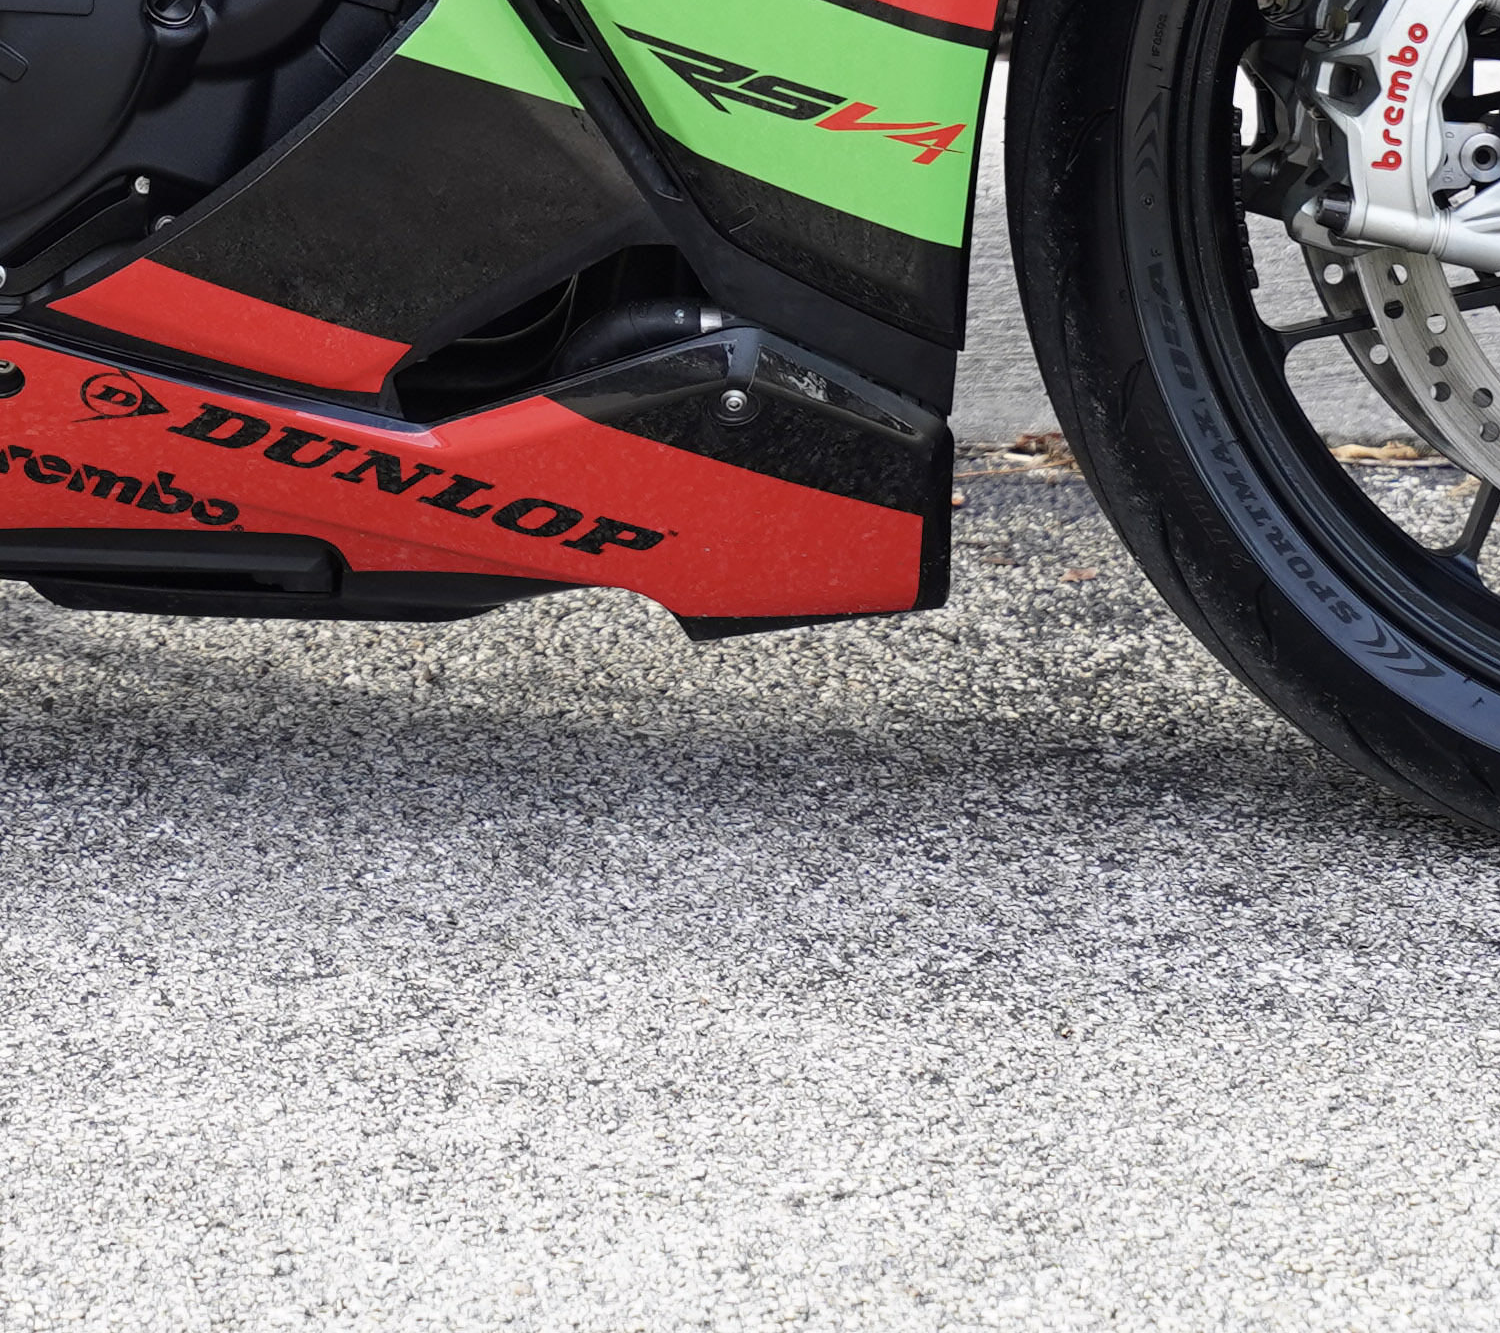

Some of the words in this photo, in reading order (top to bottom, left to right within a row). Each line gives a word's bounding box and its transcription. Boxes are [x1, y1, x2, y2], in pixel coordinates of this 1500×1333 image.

[1371, 22, 1429, 171] brembo
[168, 401, 669, 556] DUNLOP
[1188, 399, 1364, 631] SPORTMAX
